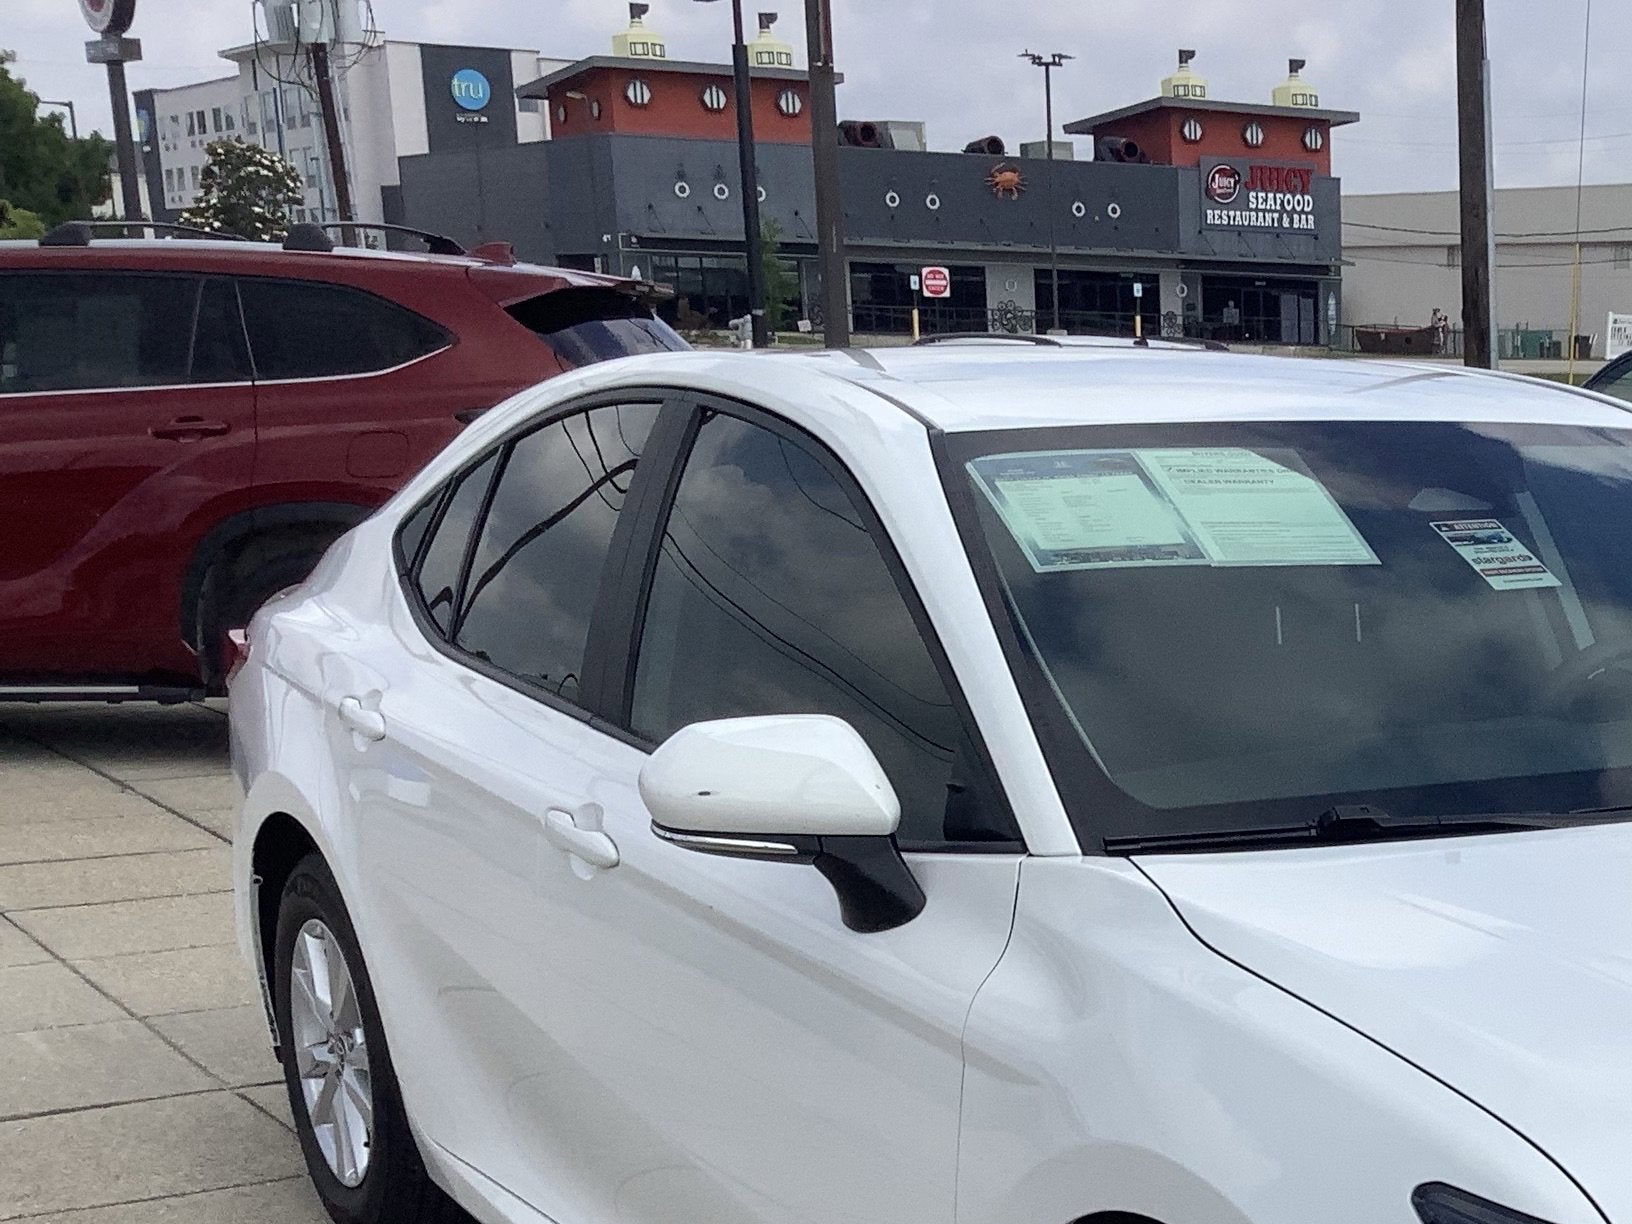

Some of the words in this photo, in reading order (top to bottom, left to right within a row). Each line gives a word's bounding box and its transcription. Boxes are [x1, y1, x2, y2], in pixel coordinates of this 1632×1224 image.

[452, 78, 483, 98] tru
[1244, 166, 1313, 193] JUICY
[1248, 191, 1314, 212] SEAFOOD
[1206, 209, 1279, 227] RESTAURANT
[1281, 213, 1290, 228] &
[1293, 214, 1315, 229] BAR
